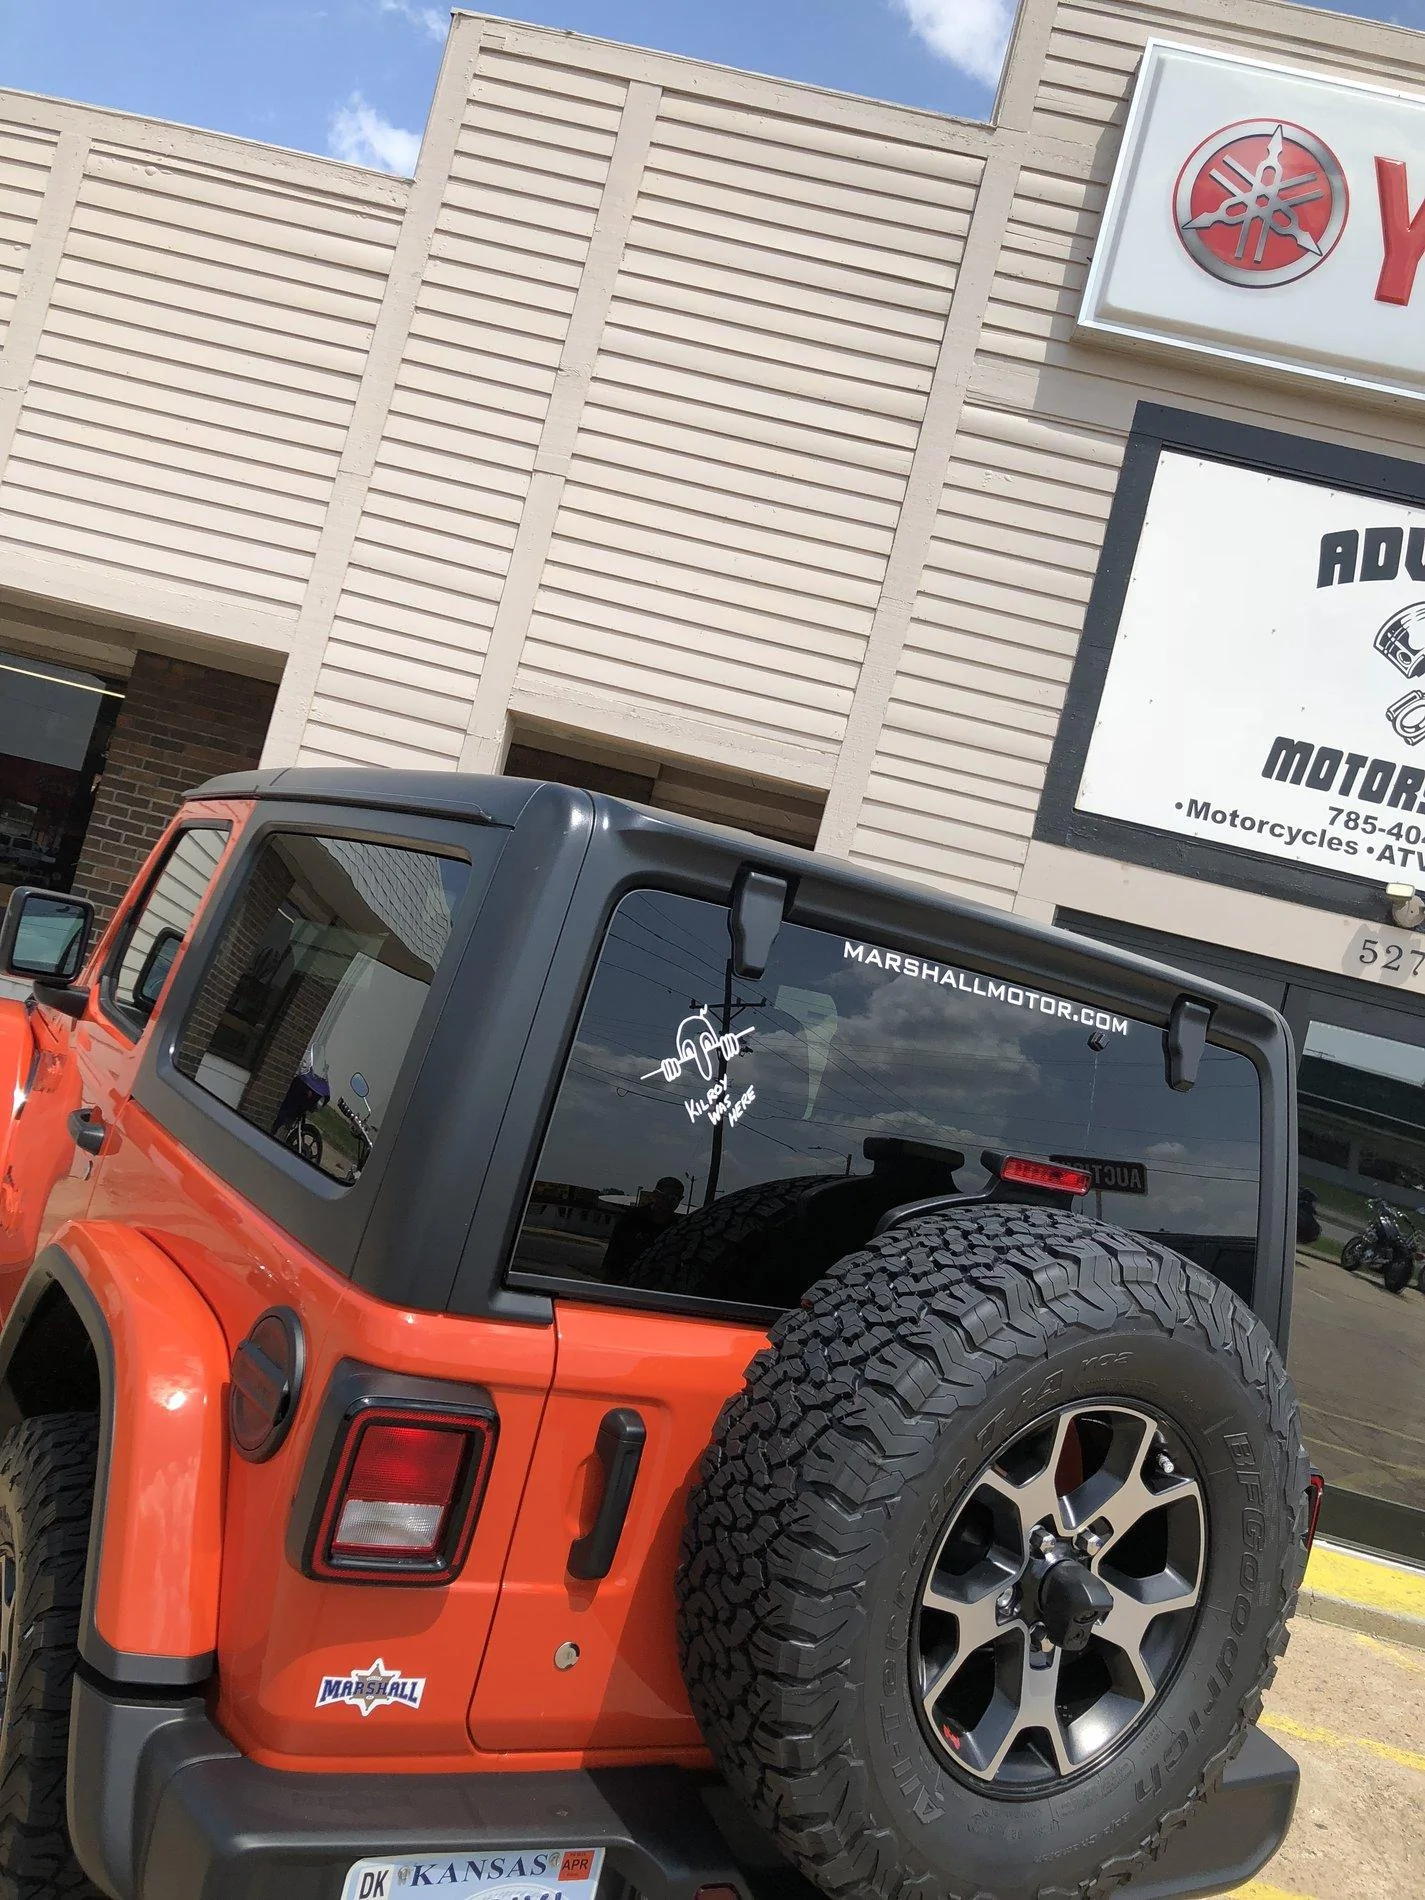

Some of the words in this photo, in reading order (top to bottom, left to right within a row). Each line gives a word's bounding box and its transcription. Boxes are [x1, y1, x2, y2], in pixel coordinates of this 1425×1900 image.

[1374, 156, 1425, 306] Y
[1186, 798, 1359, 855] Motorcycles
[1328, 805, 1425, 845] 785-40
[1359, 939, 1425, 975] 527
[843, 941, 1128, 1036] MARSHALLMOTOR.COM
[684, 1073, 728, 1124] KILROY
[707, 1094, 732, 1126] WAS
[728, 1084, 757, 1128] HERE
[319, 1679, 419, 1704] MARSHALL
[410, 1853, 549, 1887] KANSAS
[562, 1858, 589, 1871] APR
[359, 1869, 389, 1900] DK
